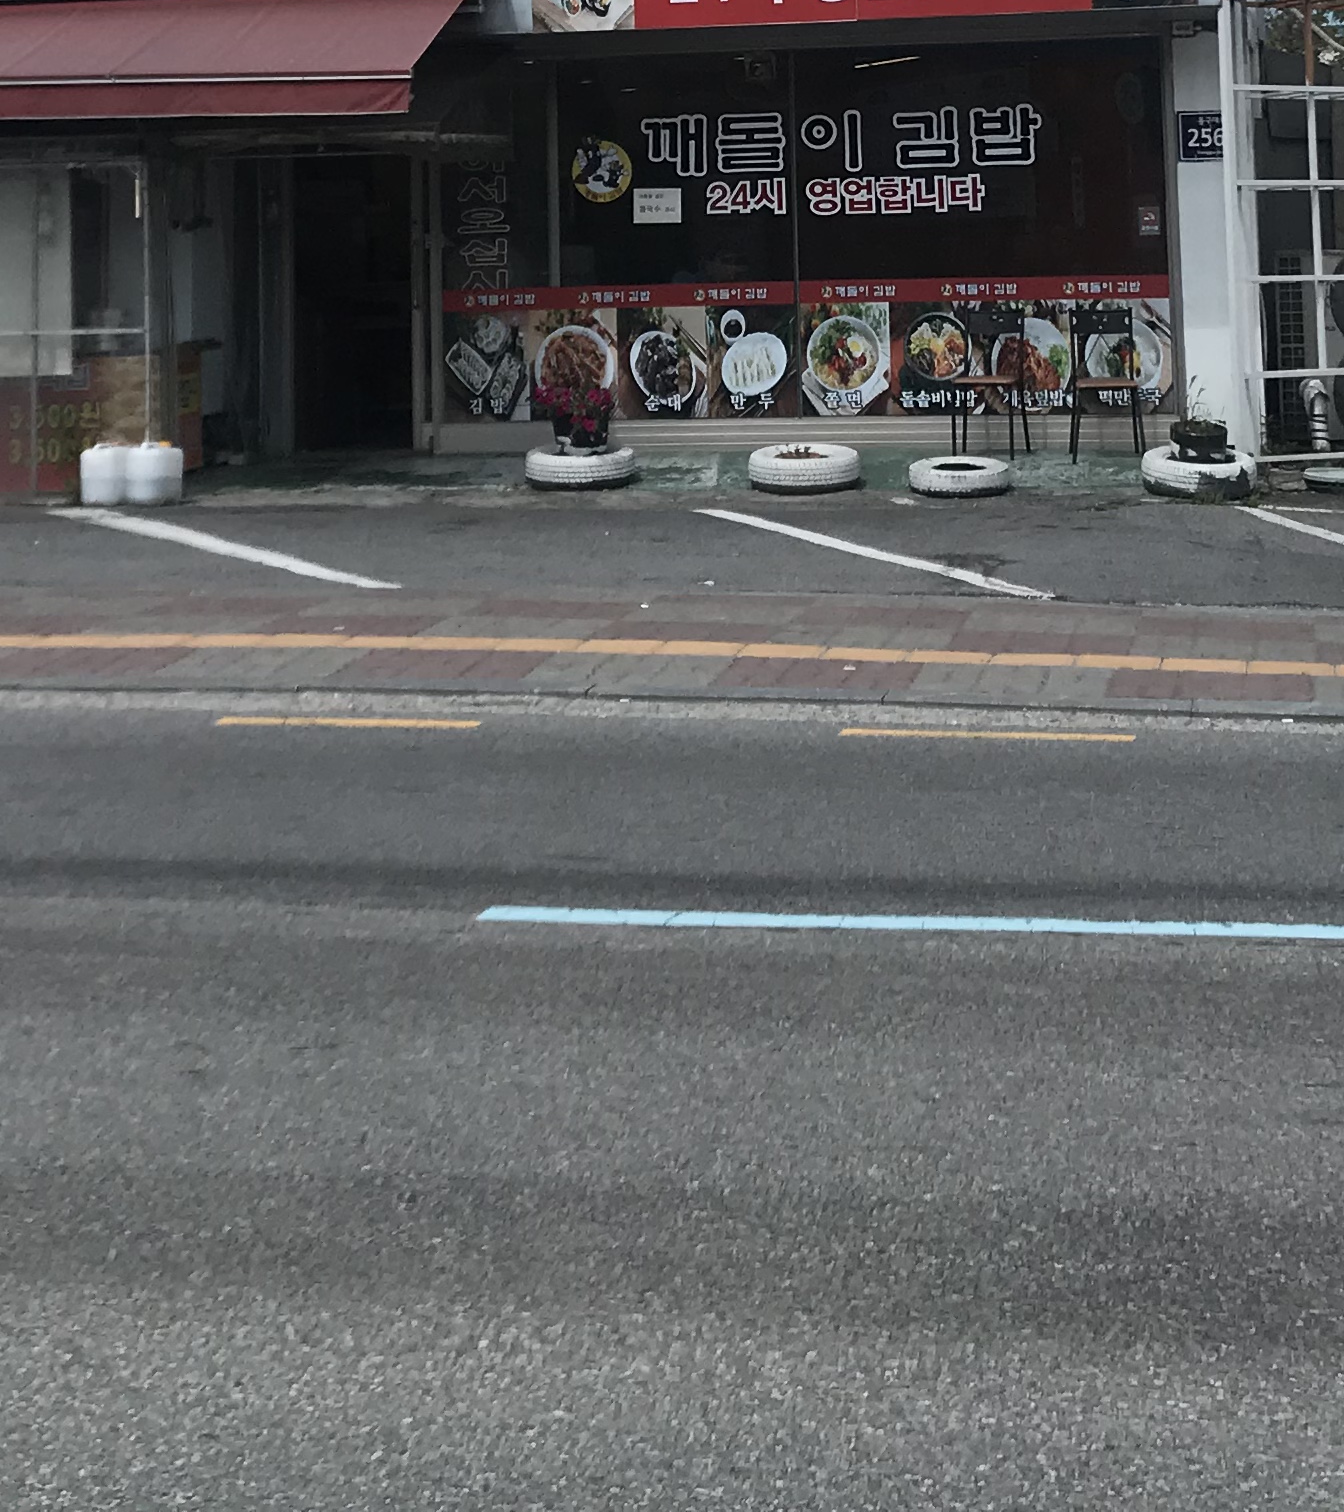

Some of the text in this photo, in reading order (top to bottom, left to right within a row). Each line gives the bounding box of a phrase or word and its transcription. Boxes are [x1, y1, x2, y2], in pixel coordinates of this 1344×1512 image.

[640, 102, 1042, 176] 깨돌이 김밥
[706, 172, 986, 216] 24시 영업합니다
